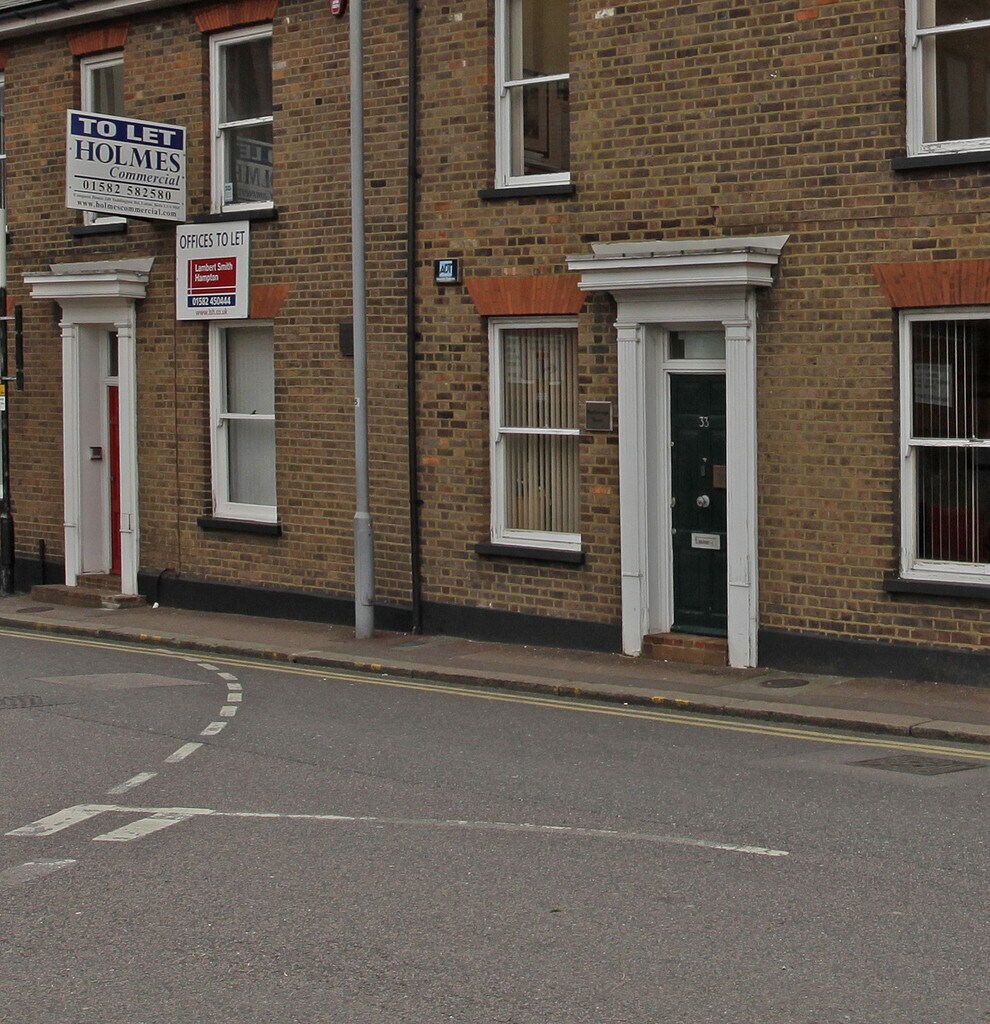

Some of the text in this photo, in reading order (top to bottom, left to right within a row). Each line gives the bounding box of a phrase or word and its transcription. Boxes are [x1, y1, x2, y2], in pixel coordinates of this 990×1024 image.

[78, 117, 176, 146] TO LET
[74, 139, 181, 173] HOLMES
[109, 166, 181, 186] Commercial
[83, 180, 121, 194] 01582
[127, 186, 171, 201] 582580
[77, 200, 177, 217] www.holmescommercial.com
[180, 231, 245, 249] OFFICES TO LET
[195, 262, 233, 272] Lambert Smith
[194, 273, 219, 283] Hampton
[192, 296, 231, 306] 01582 450444
[699, 416, 709, 427] 33
